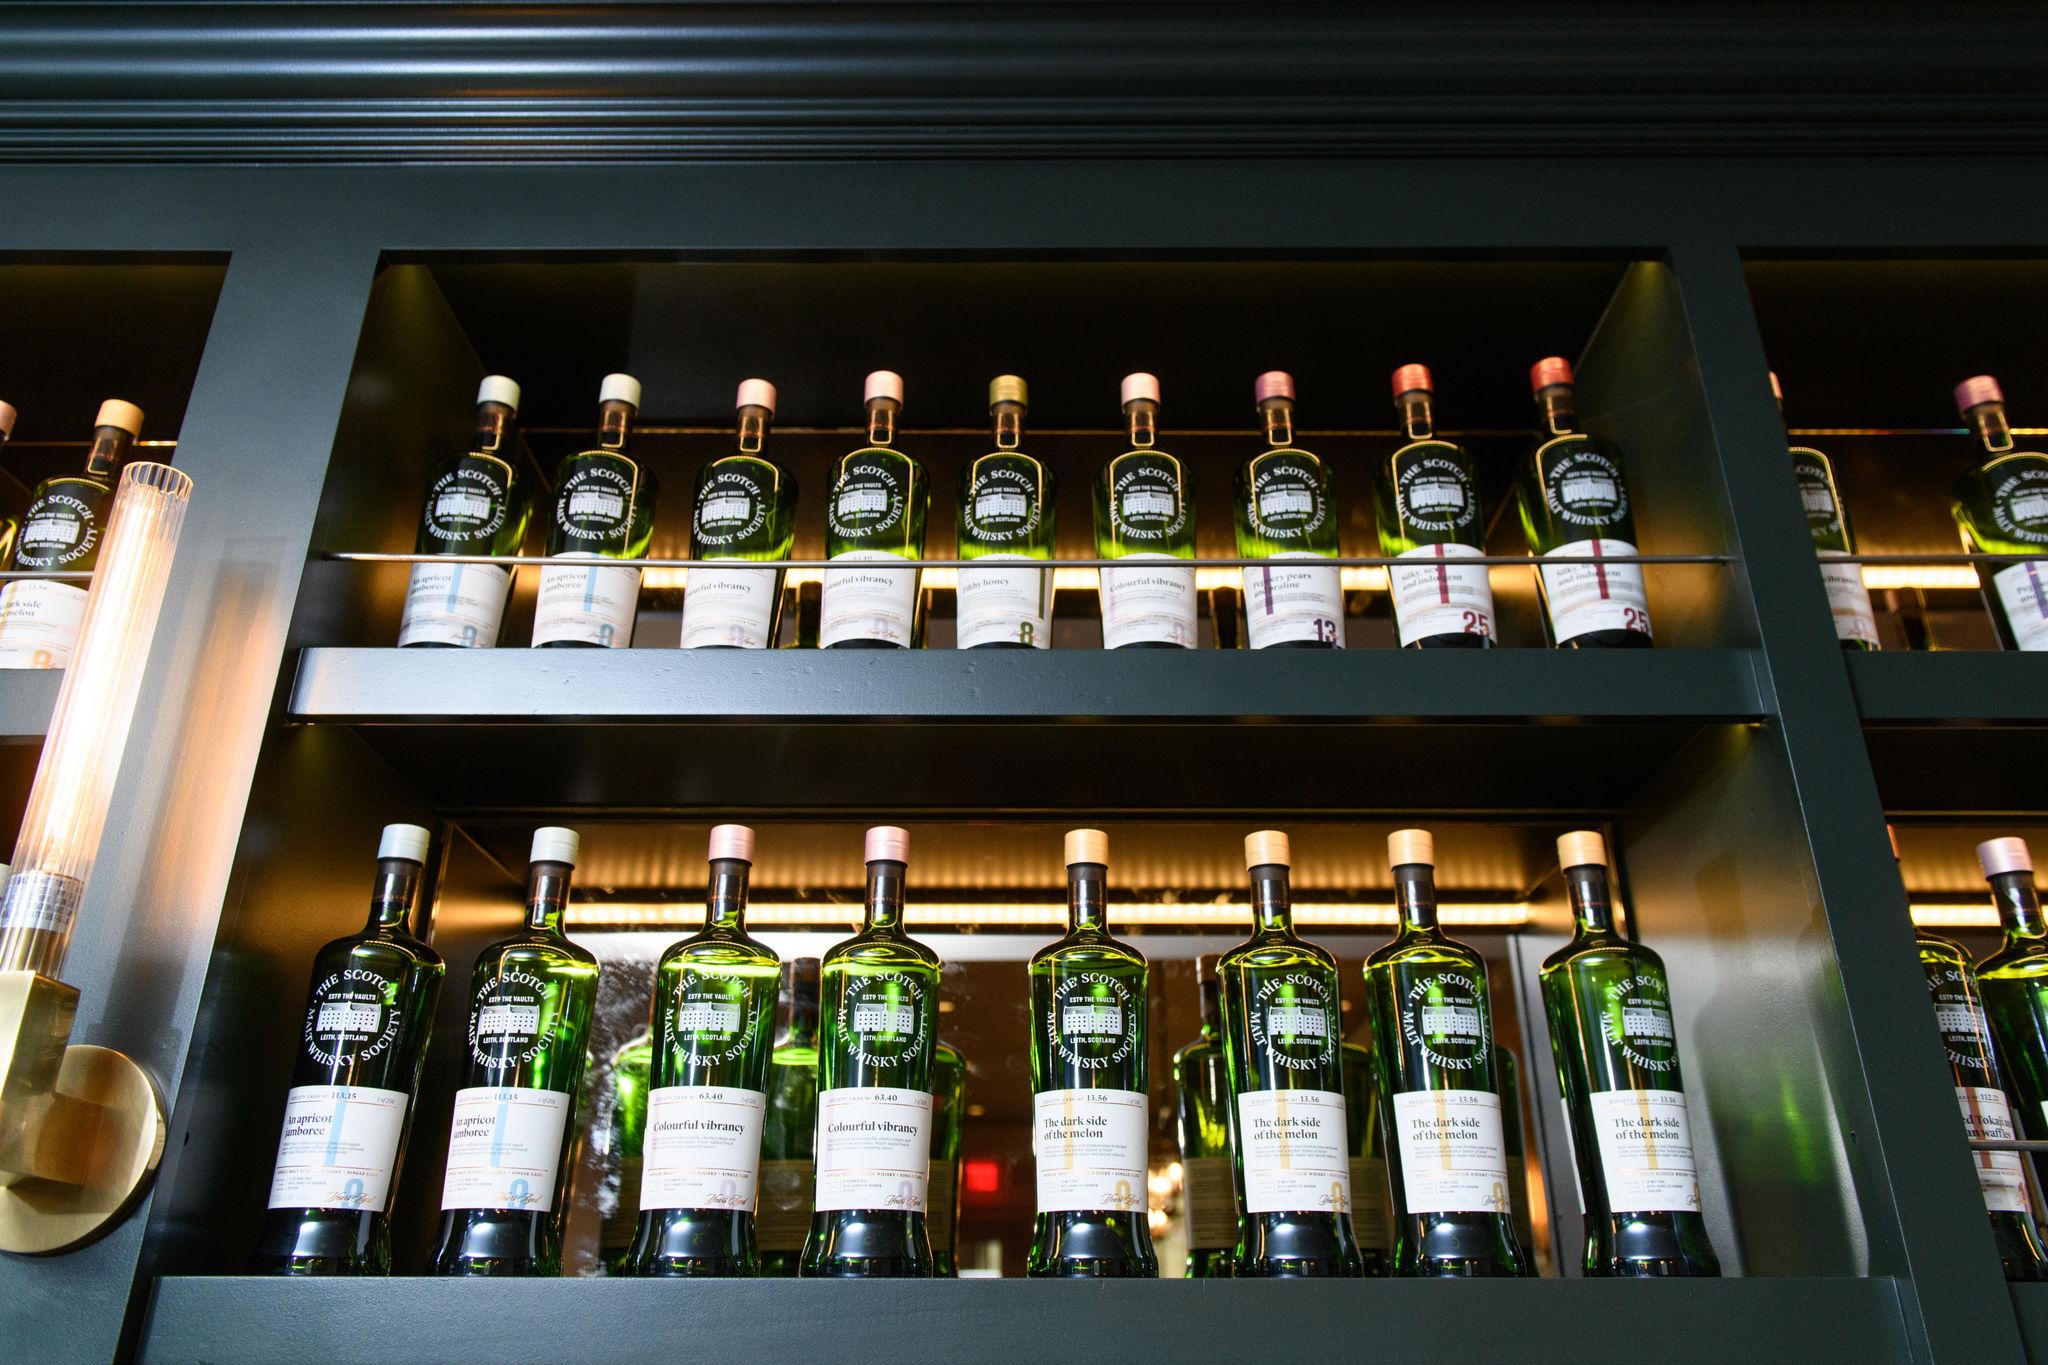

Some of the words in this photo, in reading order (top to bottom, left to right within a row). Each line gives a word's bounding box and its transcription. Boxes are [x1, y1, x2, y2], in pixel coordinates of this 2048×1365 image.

[1401, 464, 1421, 484] THE
[1423, 458, 1468, 483] SCOTCH
[1550, 457, 1573, 478] THE
[1574, 452, 1619, 477] SCOTCH
[434, 472, 455, 492] THE
[457, 469, 503, 496] SCOTCH
[566, 471, 587, 490] THE
[590, 468, 632, 495] SCOTCH
[699, 479, 716, 501] THE
[718, 473, 761, 495] SCOTCH
[833, 471, 849, 493] THE
[853, 465, 897, 487] SCOTCH
[969, 475, 988, 496] THE
[991, 469, 1035, 493] SCOTCH
[1115, 472, 1135, 492] THE
[1139, 468, 1179, 492] SCOTCH
[1254, 472, 1271, 492] THE
[1274, 466, 1318, 488] SCOTCH
[28, 498, 45, 519] THE
[48, 494, 95, 520] SCOTCH
[833, 525, 873, 538] WHISKY
[876, 495, 903, 532] SOCIETY
[1562, 511, 1610, 526] WHISKY
[429, 524, 470, 541] WHISKY
[474, 505, 506, 540] SOCIETY
[562, 522, 605, 540] WHISKY
[697, 533, 733, 545] WHISKY
[737, 502, 766, 541] SOCIETY
[972, 529, 1013, 541] WHISKY
[1017, 500, 1041, 537] SOCIETY
[1119, 525, 1163, 539] WHISKY
[1258, 525, 1302, 539] WHISKY
[1408, 516, 1455, 531] WHISKY
[58, 528, 98, 564] SOCIETY
[855, 575, 894, 587] vibrancy
[983, 576, 1009, 587] honey
[1110, 578, 1150, 593] Colourful
[1152, 577, 1186, 592] vibrancy
[1286, 573, 1312, 584] pears
[1314, 619, 1337, 642] 13
[1463, 611, 1489, 636] 25
[1623, 607, 1649, 632] 25
[1020, 621, 1034, 647] 8
[316, 974, 339, 997] THE
[343, 969, 396, 998] SCOTCH
[477, 977, 498, 1001] THE
[502, 972, 551, 1000] SCOTCH
[673, 974, 697, 997] THE
[701, 971, 753, 998] SCOTCH
[846, 975, 871, 998] THE
[876, 971, 923, 1000] SCOTCH
[1055, 977, 1077, 1000] THE
[1081, 972, 1130, 1000] SCOTCH
[1256, 978, 1283, 1001] THE
[1286, 974, 1331, 1002] SCOTCH
[1409, 978, 1435, 1001] THE
[1438, 973, 1483, 1002] SCOTCH
[1608, 979, 1634, 1001] THE
[354, 993, 376, 1001] VAULTS
[305, 1008, 316, 1042] MALT
[360, 1009, 401, 1061] SOCIETY
[469, 1012, 477, 1046] MALT
[522, 1011, 559, 1063] SOCIETY
[665, 1008, 676, 1043] MALT
[671, 1042, 721, 1066] WHISKY
[725, 1009, 758, 1061] SOCIETY
[838, 1008, 850, 1043] MALT
[847, 1042, 898, 1067] WHISKY
[902, 1013, 928, 1062] SOCIETY
[1048, 1011, 1060, 1045] MALT
[1058, 1045, 1109, 1069] WHISKY
[1112, 1012, 1136, 1063] SOCIETY
[1250, 1012, 1268, 1046] MALT
[1266, 1046, 1317, 1070] WHISKY
[1403, 1011, 1421, 1046] MALT
[1420, 1046, 1473, 1069] WHISKY
[1602, 1011, 1623, 1046] MALT
[1622, 1046, 1671, 1071] WHISKY
[307, 1042, 356, 1067] WHISKY
[472, 1048, 518, 1068] WHISKY
[331, 1092, 357, 1100] 113.15
[699, 1092, 723, 1100] 63.40
[297, 1113, 332, 1125] apricot
[463, 1115, 496, 1127] apricot
[653, 1120, 698, 1132] Colourful
[701, 1120, 745, 1135] vibrancy
[828, 1121, 875, 1133] Colourful
[878, 1122, 918, 1136] vibrancy
[1044, 1118, 1058, 1128] The
[1060, 1116, 1085, 1127] dark
[1086, 1115, 1108, 1126] side
[1254, 1118, 1271, 1128] The
[1274, 1117, 1299, 1127] dark
[1301, 1117, 1320, 1127] side
[1412, 1119, 1431, 1128] The
[1433, 1118, 1459, 1127] dark
[1461, 1117, 1480, 1128] side
[1615, 1118, 1635, 1127] The
[1638, 1117, 1662, 1126] dark
[1664, 1117, 1680, 1128] side
[285, 1127, 325, 1138] jamboree
[1044, 1130, 1053, 1141] of
[1053, 1129, 1067, 1139] the
[1070, 1128, 1103, 1138] melon
[1254, 1130, 1266, 1140] of
[1266, 1130, 1282, 1139] the
[1285, 1130, 1318, 1139] melon
[1413, 1131, 1425, 1141] of
[1425, 1131, 1442, 1140] the
[1445, 1131, 1478, 1139] melon
[1616, 1130, 1629, 1139] of
[1629, 1129, 1647, 1139] the
[1650, 1129, 1679, 1139] melon
